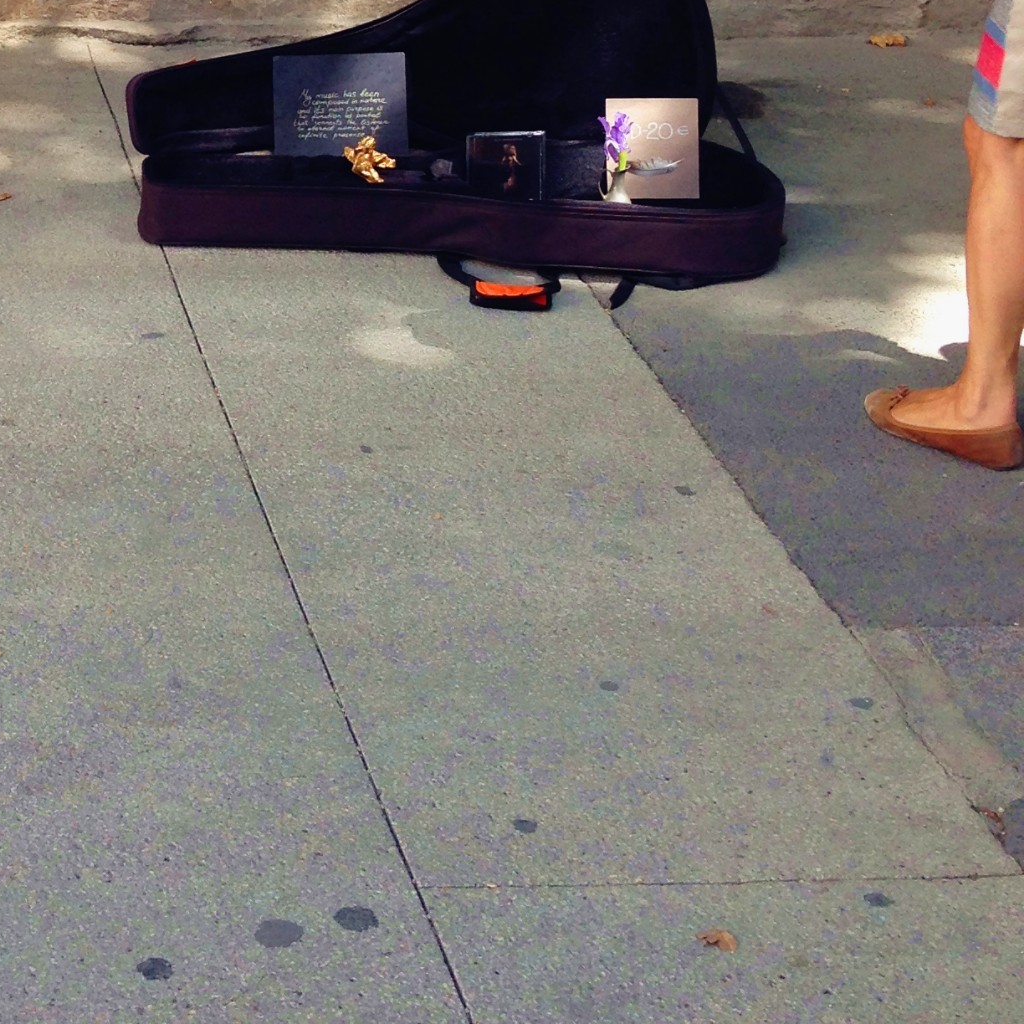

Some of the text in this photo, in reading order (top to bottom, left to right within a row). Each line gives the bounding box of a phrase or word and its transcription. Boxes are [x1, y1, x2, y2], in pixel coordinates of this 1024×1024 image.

[299, 89, 312, 106] My
[343, 89, 357, 97] has
[360, 88, 380, 97] been
[311, 99, 350, 108] composed
[346, 106, 374, 114] purpose
[293, 119, 308, 127] that
[677, 125, 689, 136] €
